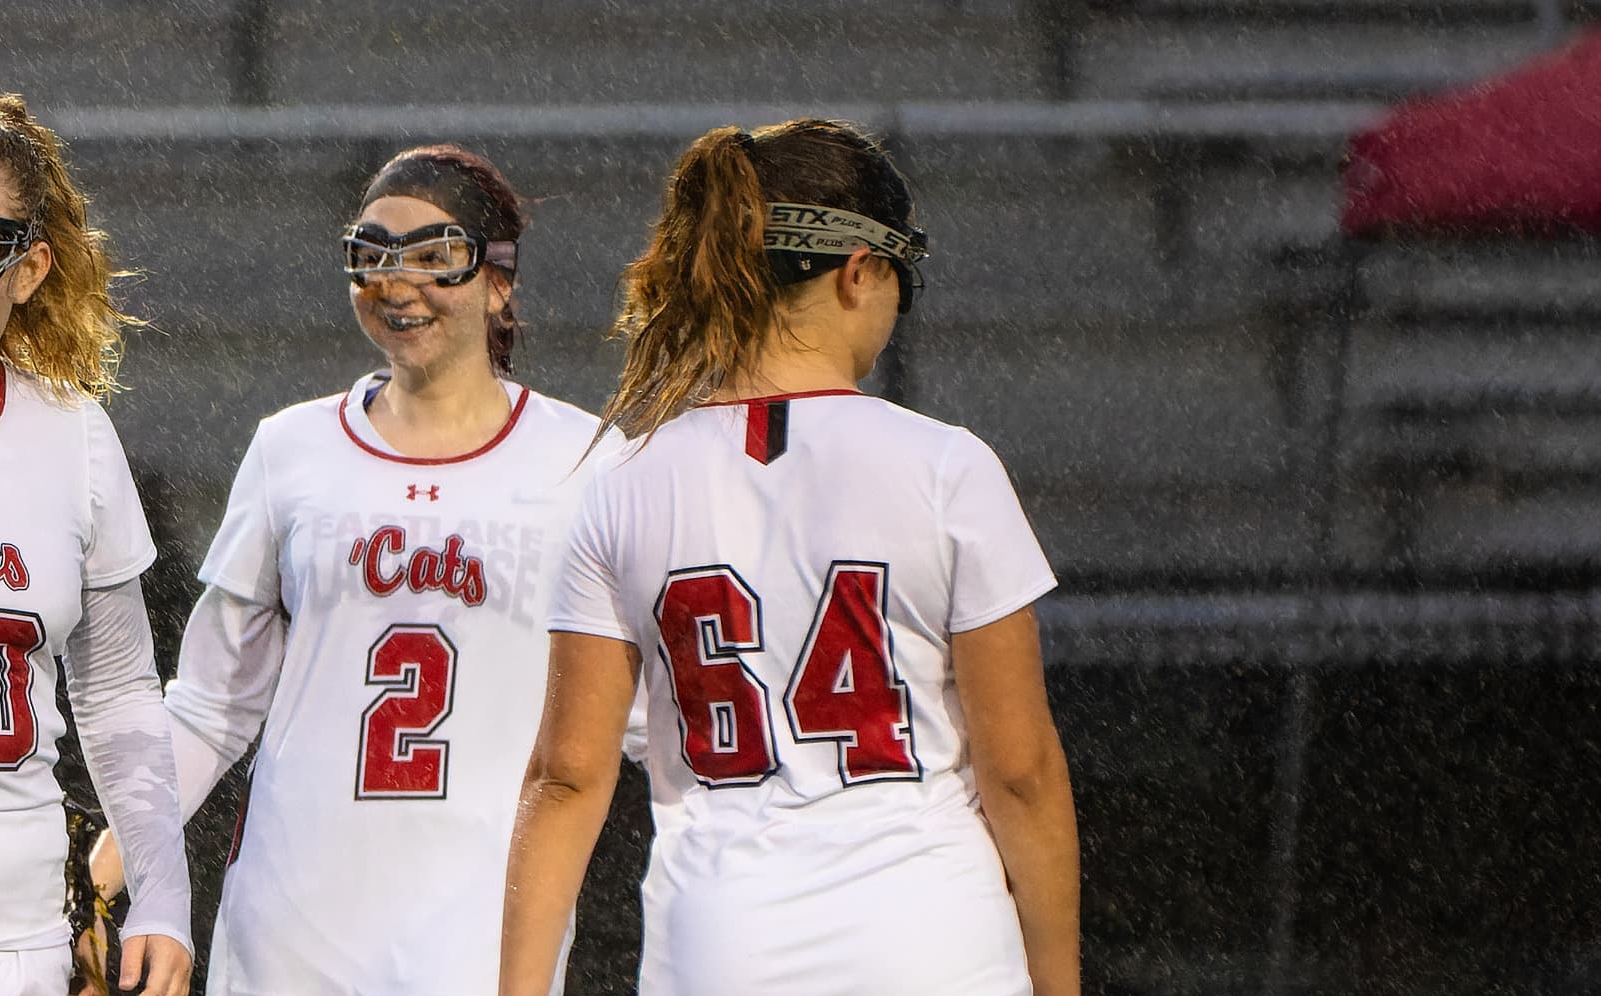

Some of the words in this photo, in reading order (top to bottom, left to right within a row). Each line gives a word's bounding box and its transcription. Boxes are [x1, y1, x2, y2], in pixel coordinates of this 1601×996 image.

[763, 230, 815, 249] STX
[816, 238, 844, 248] PLUS
[771, 205, 831, 226] STX
[831, 216, 864, 229] PLUS
[354, 624, 459, 800] 2
[653, 560, 924, 790] 64
